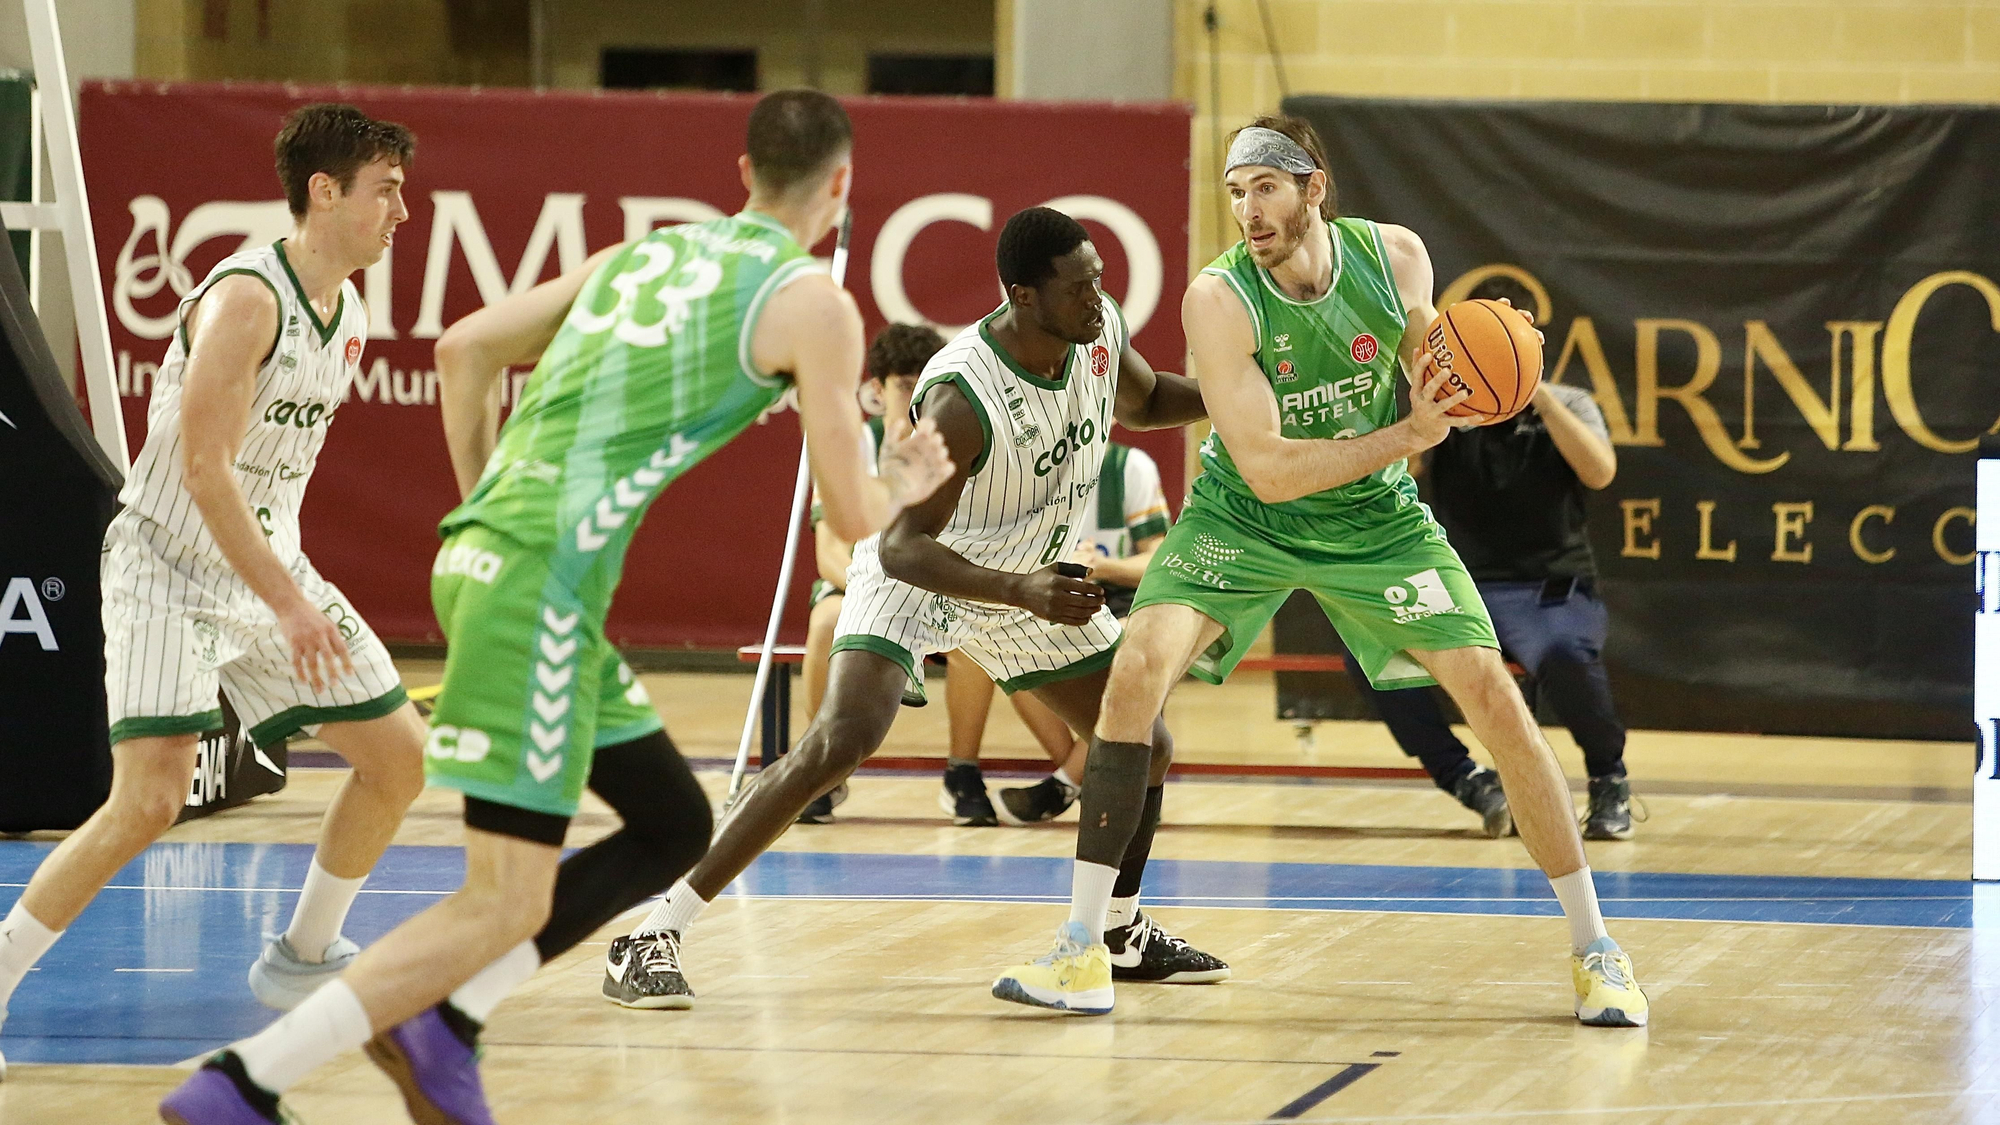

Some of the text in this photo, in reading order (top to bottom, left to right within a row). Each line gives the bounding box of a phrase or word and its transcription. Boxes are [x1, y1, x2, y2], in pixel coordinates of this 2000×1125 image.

[568, 242, 723, 348] 33
[1282, 371, 1374, 413] AMICS
[1040, 525, 1070, 565] 8
